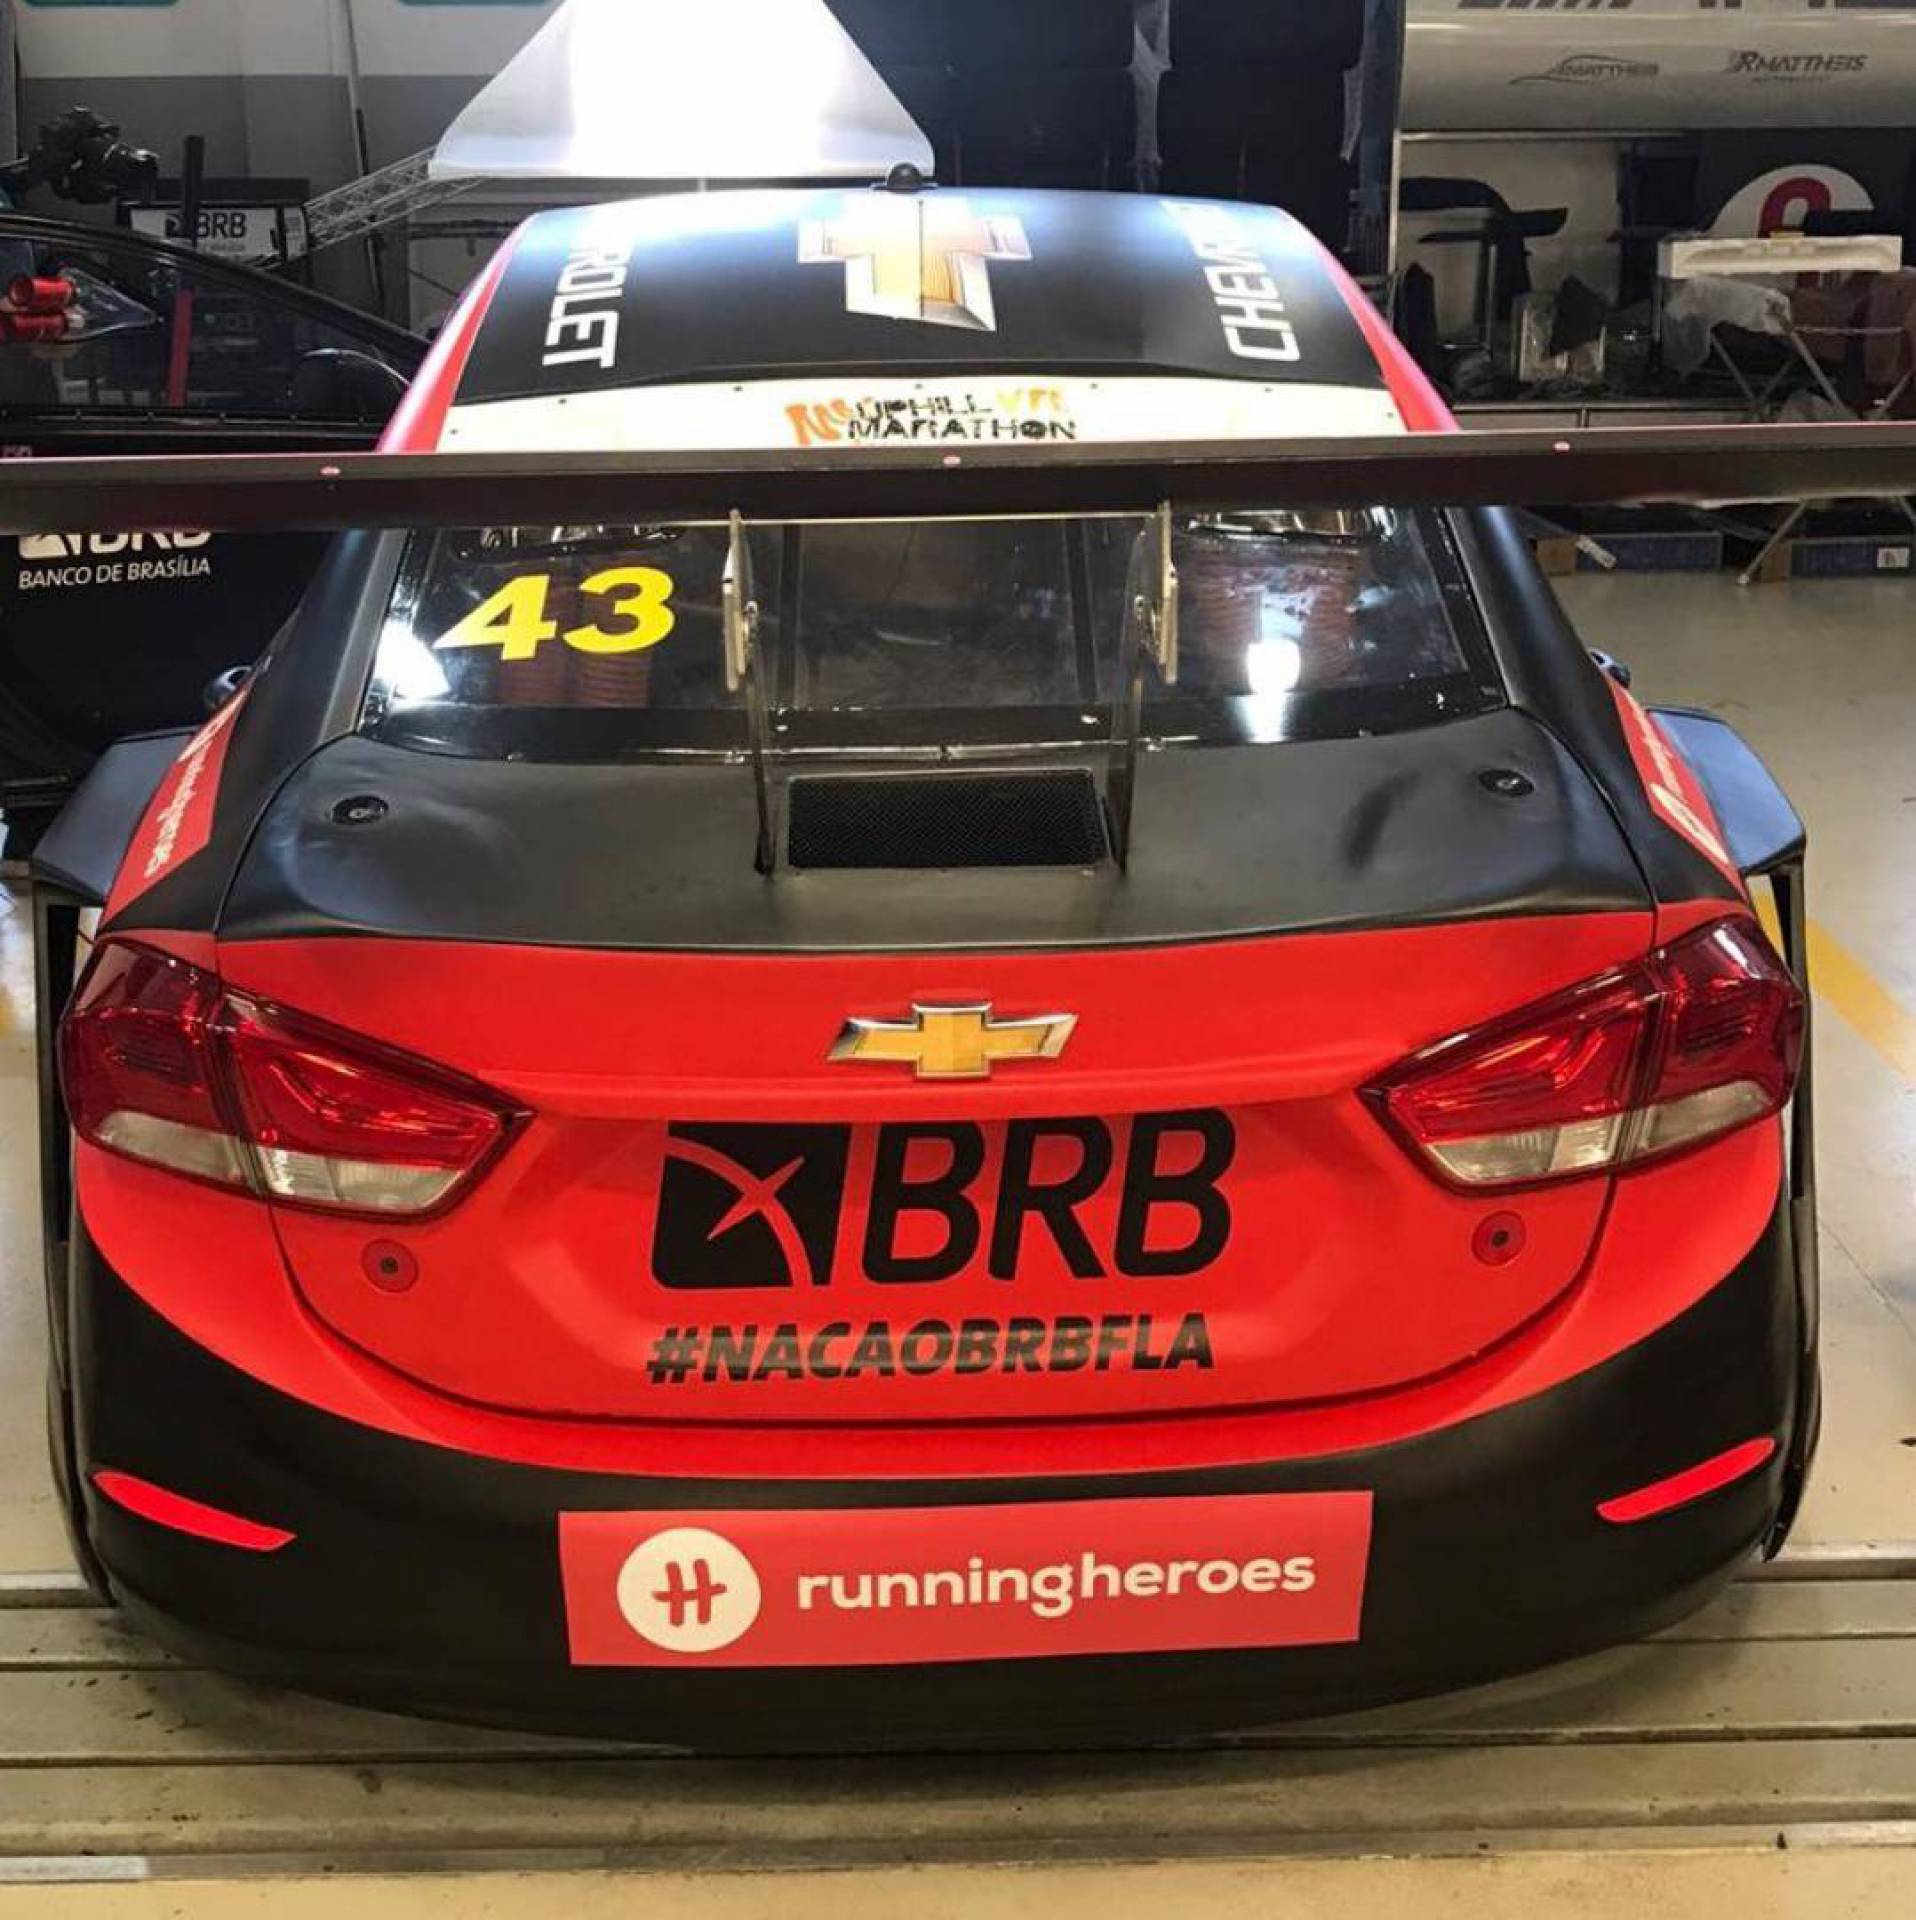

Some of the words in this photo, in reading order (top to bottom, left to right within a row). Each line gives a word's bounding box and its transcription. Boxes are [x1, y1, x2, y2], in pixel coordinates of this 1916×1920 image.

[196, 212, 246, 239] BRB
[542, 250, 629, 369] ROLET
[848, 418, 1076, 440] MARATHON
[855, 394, 993, 420] UPHILL
[18, 566, 92, 589] BANCO
[95, 563, 124, 584] DE
[127, 554, 211, 581] BRASÍLIA
[432, 566, 676, 661] 43
[861, 1106, 1237, 1284] BRB
[645, 1312, 1216, 1384] #NACAOBRBFLA
[796, 1552, 1317, 1619] runningheroes
